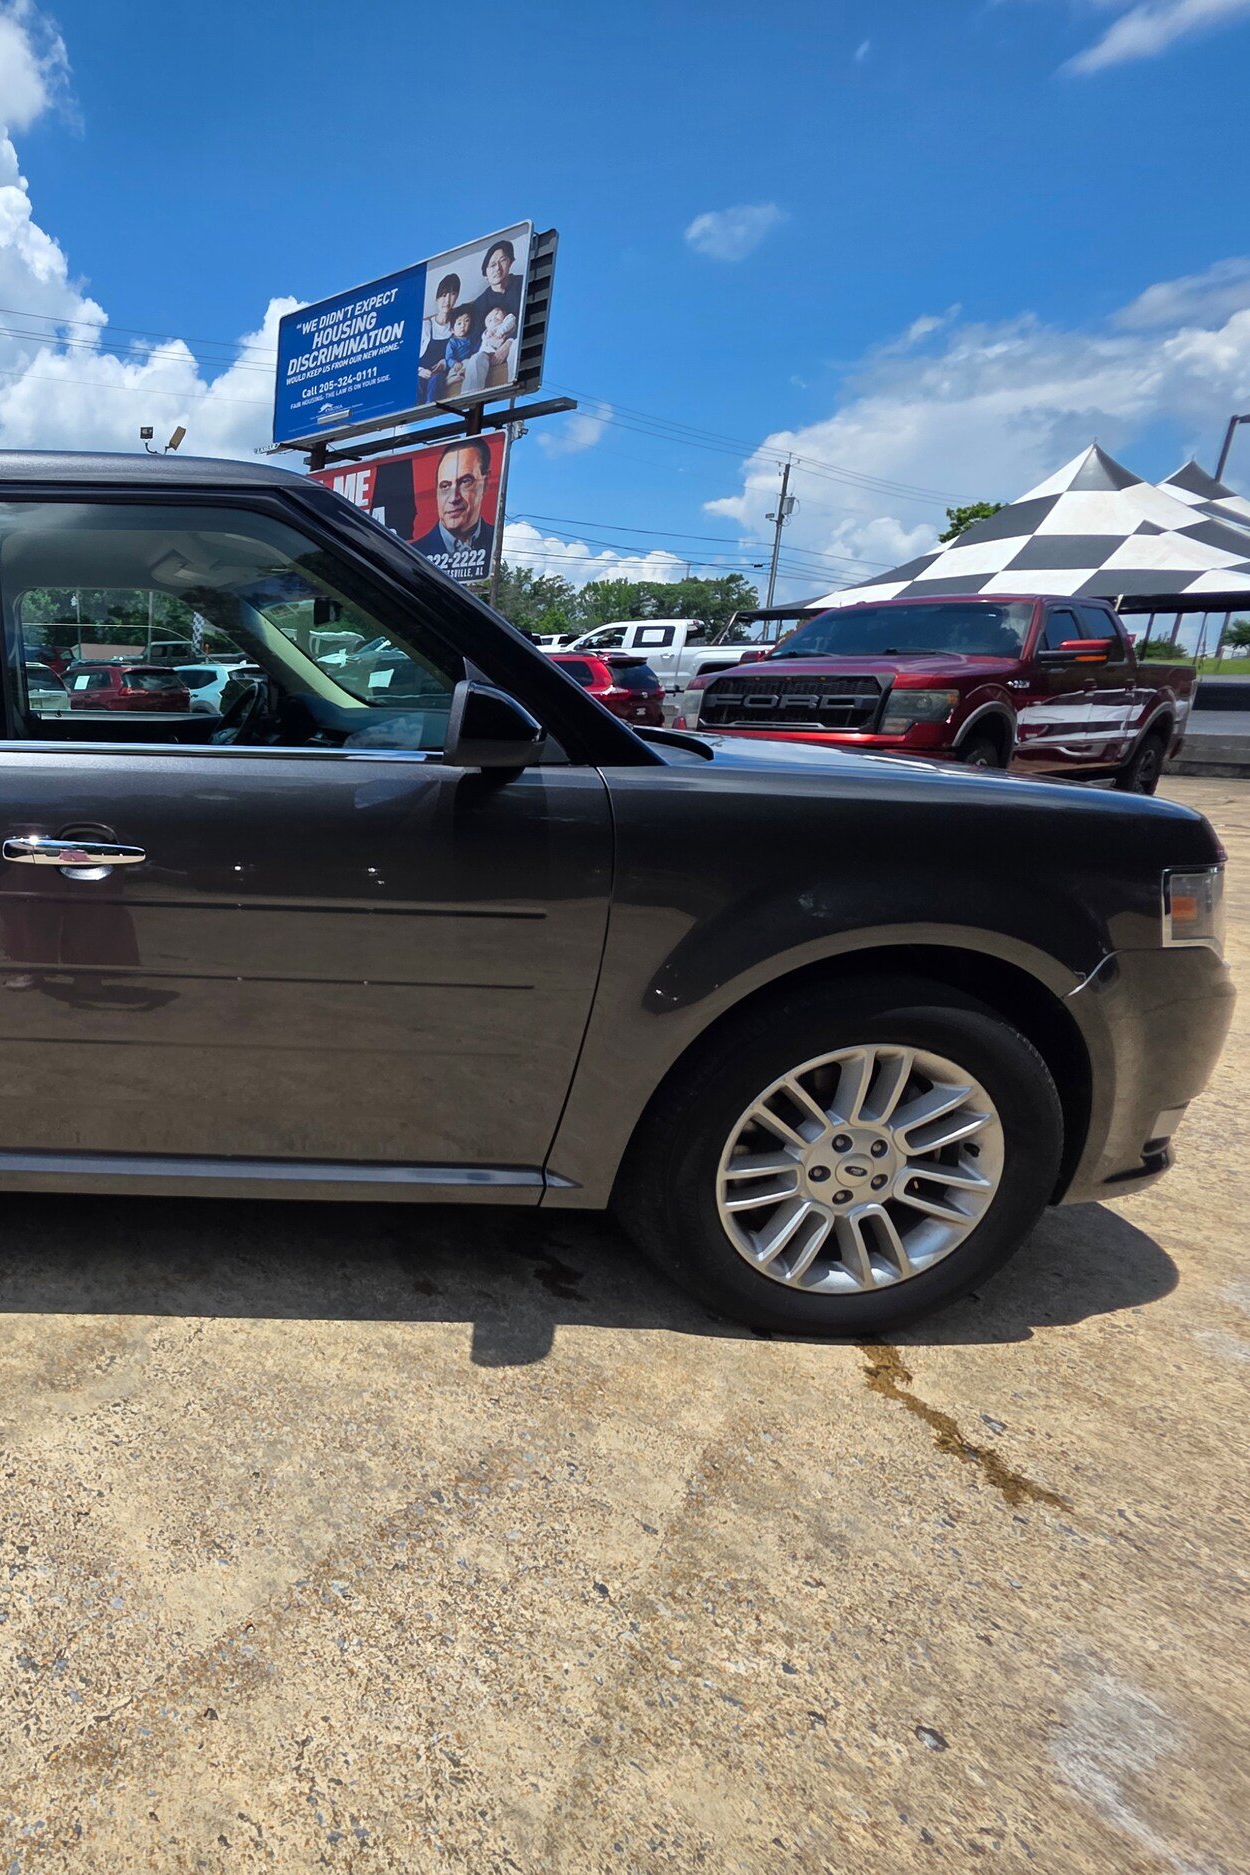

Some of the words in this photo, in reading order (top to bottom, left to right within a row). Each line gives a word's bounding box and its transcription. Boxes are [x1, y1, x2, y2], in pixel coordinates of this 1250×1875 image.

[354, 288, 398, 314] EXPECT
[312, 311, 377, 349] HOUSING
[287, 320, 405, 376] DISCRIMINATION
[286, 371, 307, 385] WOULD
[306, 367, 322, 379] KEEP
[322, 364, 331, 374] US
[331, 358, 349, 371] FROM
[349, 354, 362, 365] OUR
[362, 348, 379, 361] NEW
[302, 385, 317, 398] Call
[319, 366, 378, 394] 205-324-0111
[290, 400, 302, 410] FAIR
[325, 390, 336, 399] THE
[336, 387, 348, 396] LAW
[353, 382, 362, 390] ON
[362, 378, 377, 387] YOUR
[333, 469, 371, 507] ME
[444, 567, 473, 578] TSVILLE,
[475, 566, 484, 576] AL
[707, 693, 872, 709] FORD
